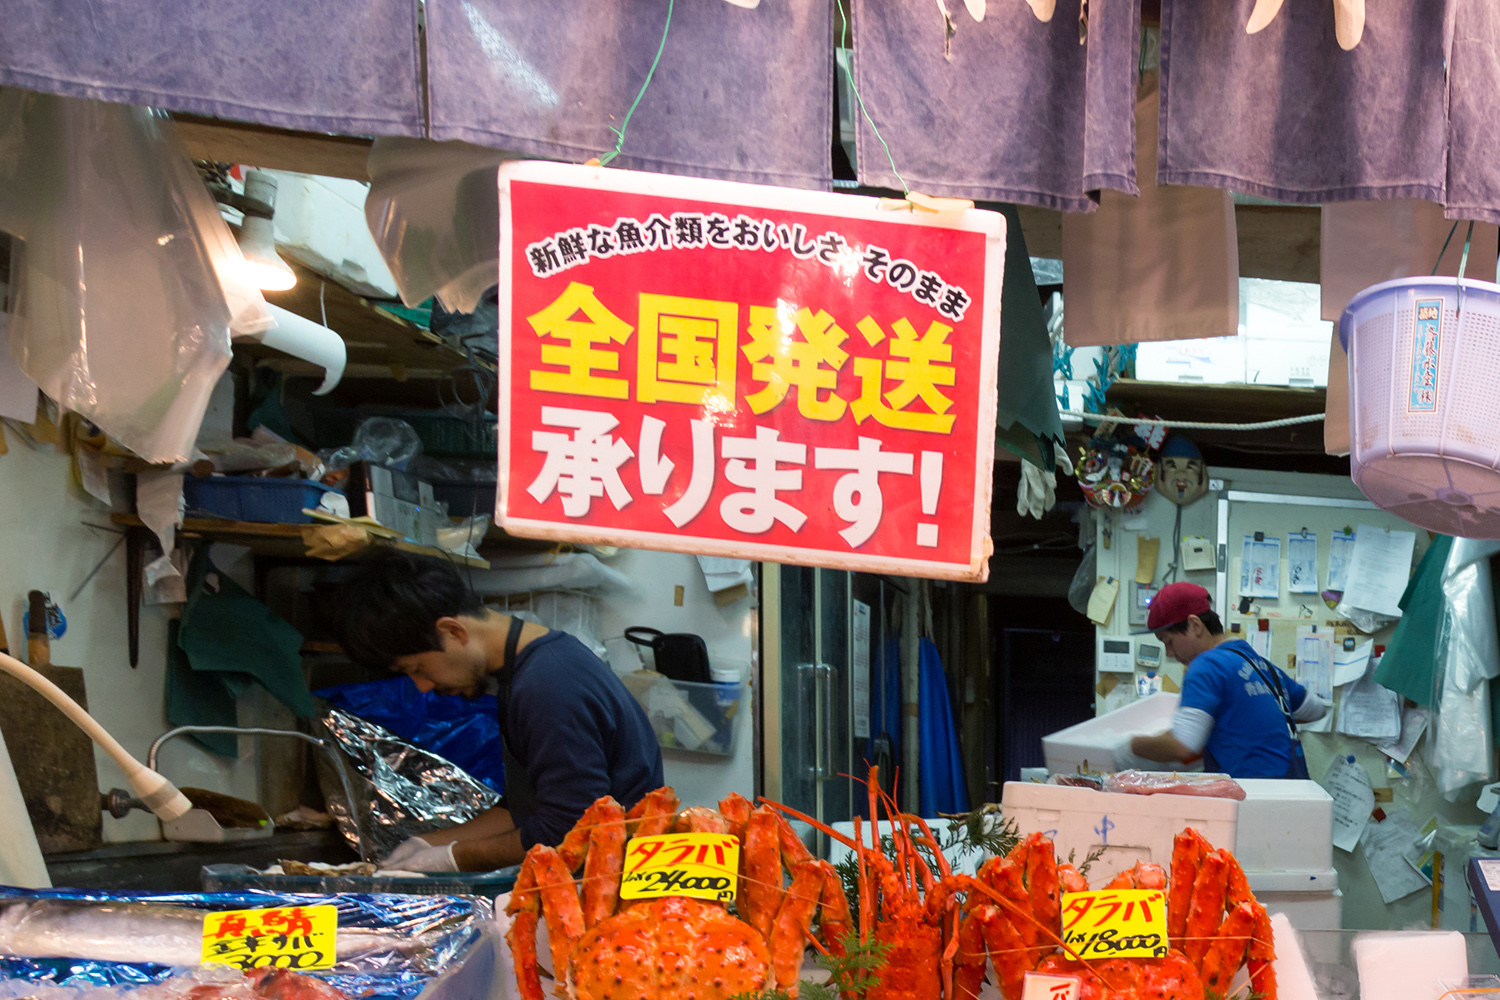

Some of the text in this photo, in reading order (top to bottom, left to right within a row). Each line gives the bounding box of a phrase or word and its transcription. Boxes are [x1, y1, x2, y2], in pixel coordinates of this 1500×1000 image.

[531, 216, 968, 319] 新鮮な魚介類をおいしさそのまま
[527, 281, 957, 434] 全国発送
[527, 406, 943, 548] 承ります!
[629, 839, 739, 871] タラバ
[1063, 894, 1162, 931] タラバ
